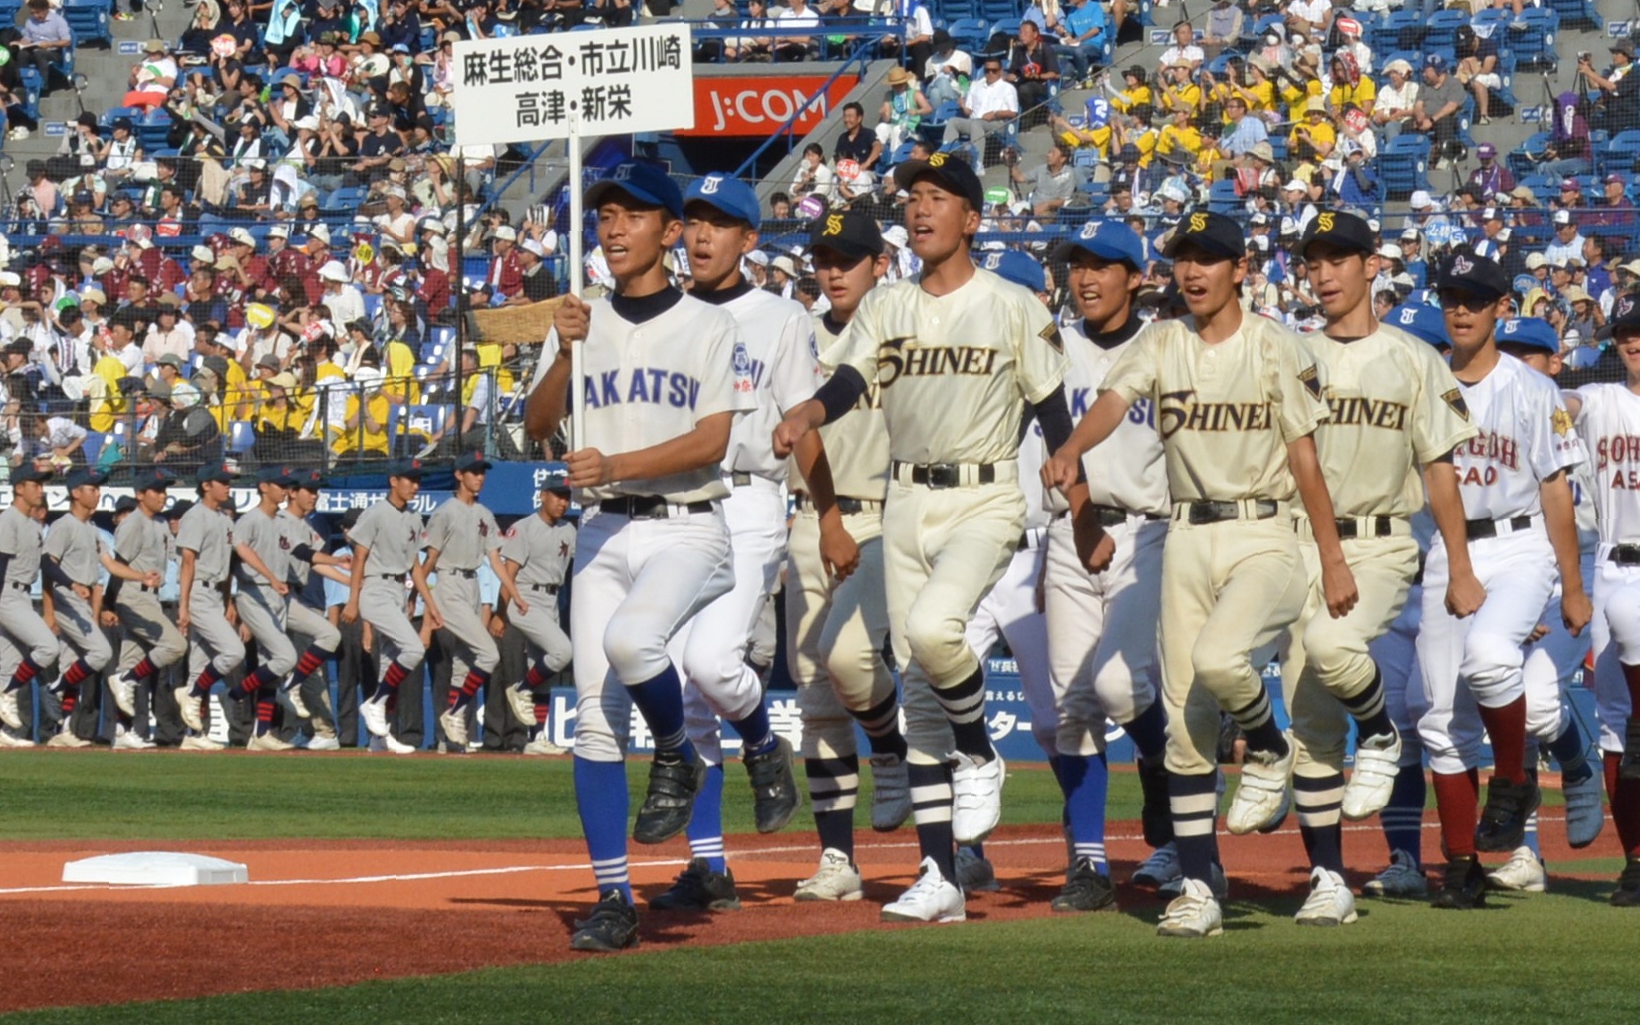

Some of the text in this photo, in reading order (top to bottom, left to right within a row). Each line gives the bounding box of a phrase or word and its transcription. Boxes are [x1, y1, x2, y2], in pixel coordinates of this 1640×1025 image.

[463, 35, 681, 86] 麻生総合・市立川崎
[515, 84, 632, 128] 高津・新栄
[713, 89, 829, 132] J:COM
[877, 336, 999, 389] SHINEI
[585, 366, 701, 413] AKATSU
[1160, 390, 1272, 440] SHINEI
[984, 710, 1032, 741] ター
